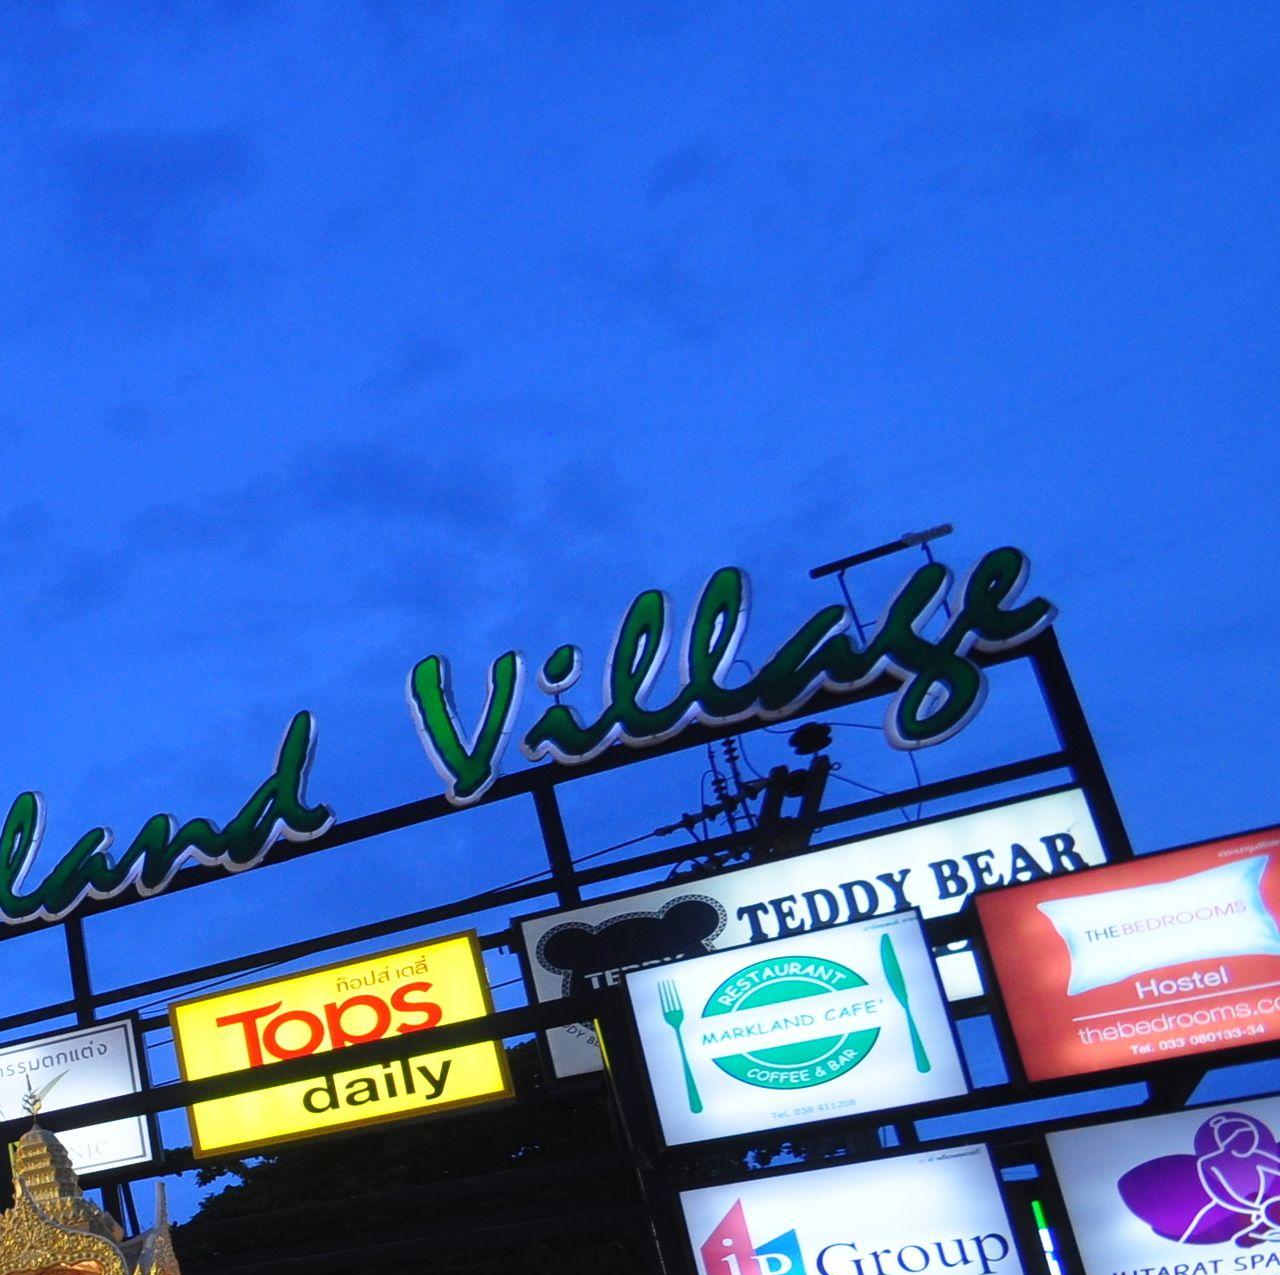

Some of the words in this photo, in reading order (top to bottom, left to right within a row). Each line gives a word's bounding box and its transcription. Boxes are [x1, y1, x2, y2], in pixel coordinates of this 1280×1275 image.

[406, 546, 1059, 806] Village
[737, 867, 912, 944] TEDDY
[928, 832, 1091, 900] BEAR
[716, 962, 848, 1008] RESTAURANT
[1134, 965, 1229, 1000] Hostel
[215, 980, 443, 1069] Tops
[701, 1013, 815, 1046] MARKLAND
[302, 1055, 453, 1114] daily
[746, 1067, 811, 1084] COFFEE
[814, 1065, 828, 1079] &
[827, 1048, 860, 1073] BAR
